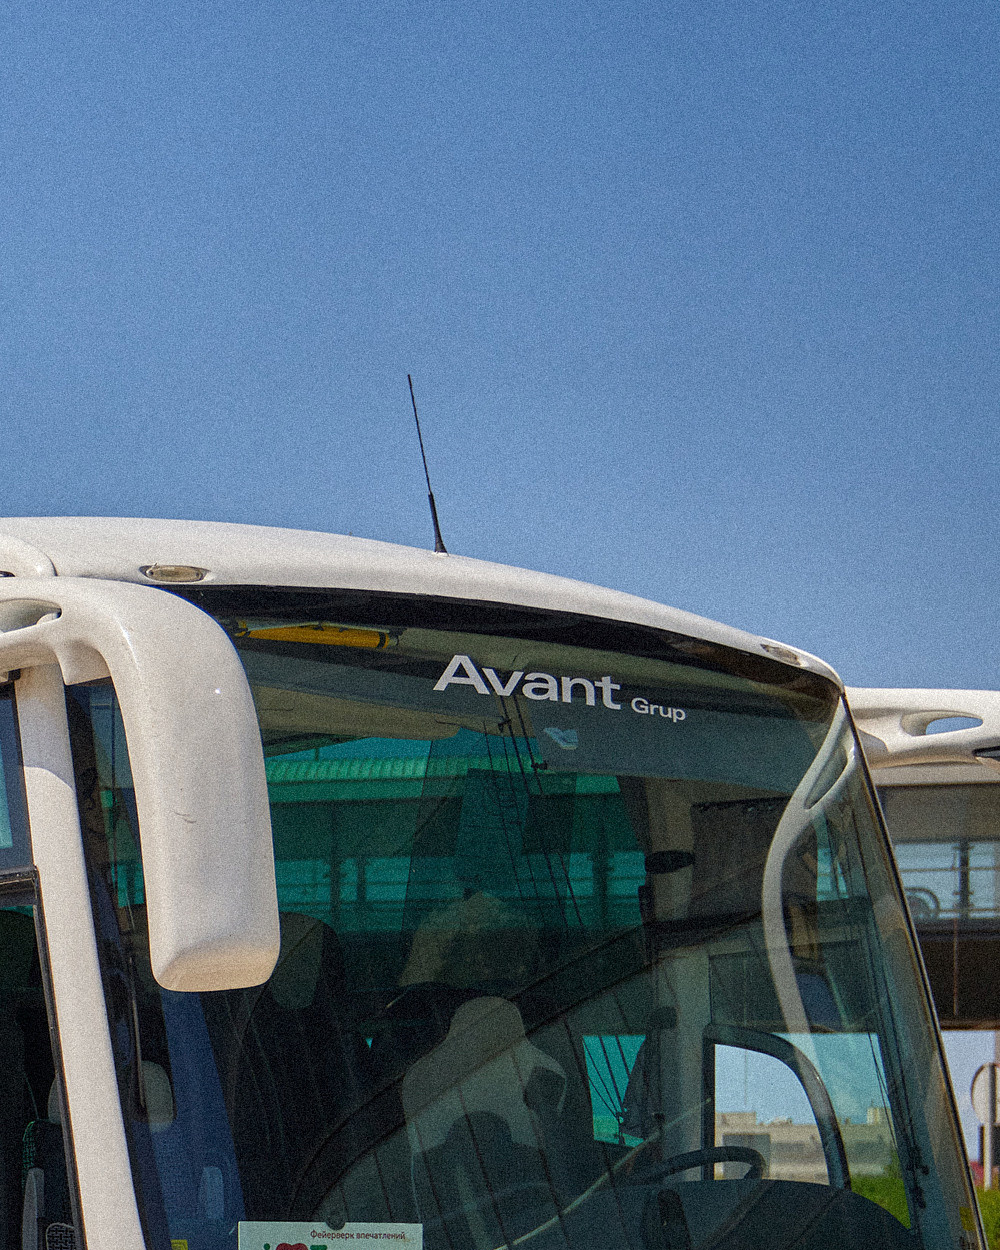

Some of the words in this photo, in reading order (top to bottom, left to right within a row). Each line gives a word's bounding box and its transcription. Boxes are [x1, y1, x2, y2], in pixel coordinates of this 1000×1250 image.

[433, 654, 622, 710] Avant
[630, 697, 687, 723] Grup
[310, 1230, 355, 1241] Фейерверк
[356, 1231, 405, 1240] впечатлений
